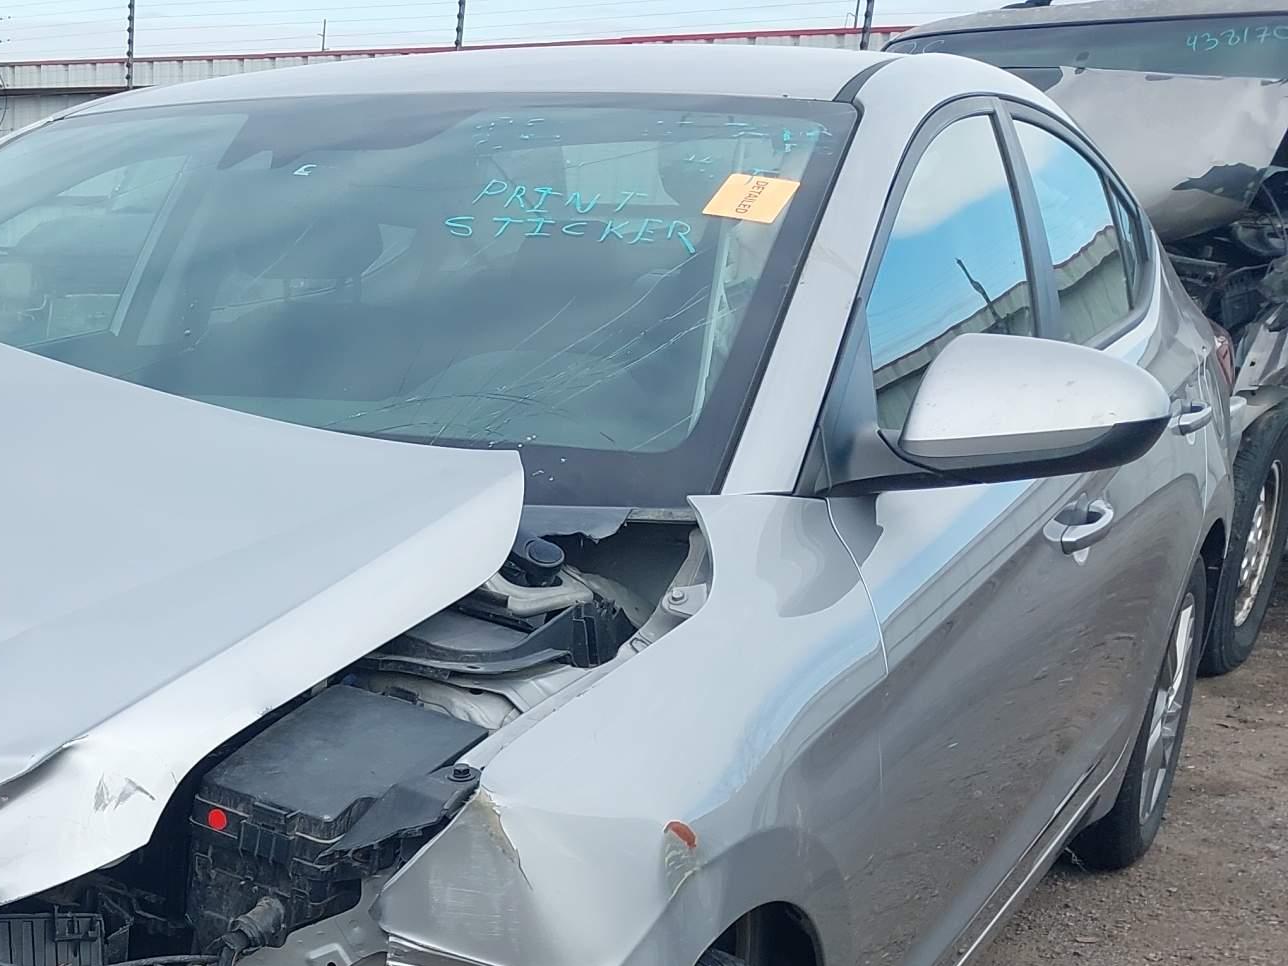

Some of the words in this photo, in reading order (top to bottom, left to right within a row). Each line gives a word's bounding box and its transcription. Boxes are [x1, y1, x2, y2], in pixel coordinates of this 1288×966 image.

[472, 179, 649, 213] PRINT
[735, 180, 769, 214] DETAILED
[445, 216, 696, 254] STICKER
